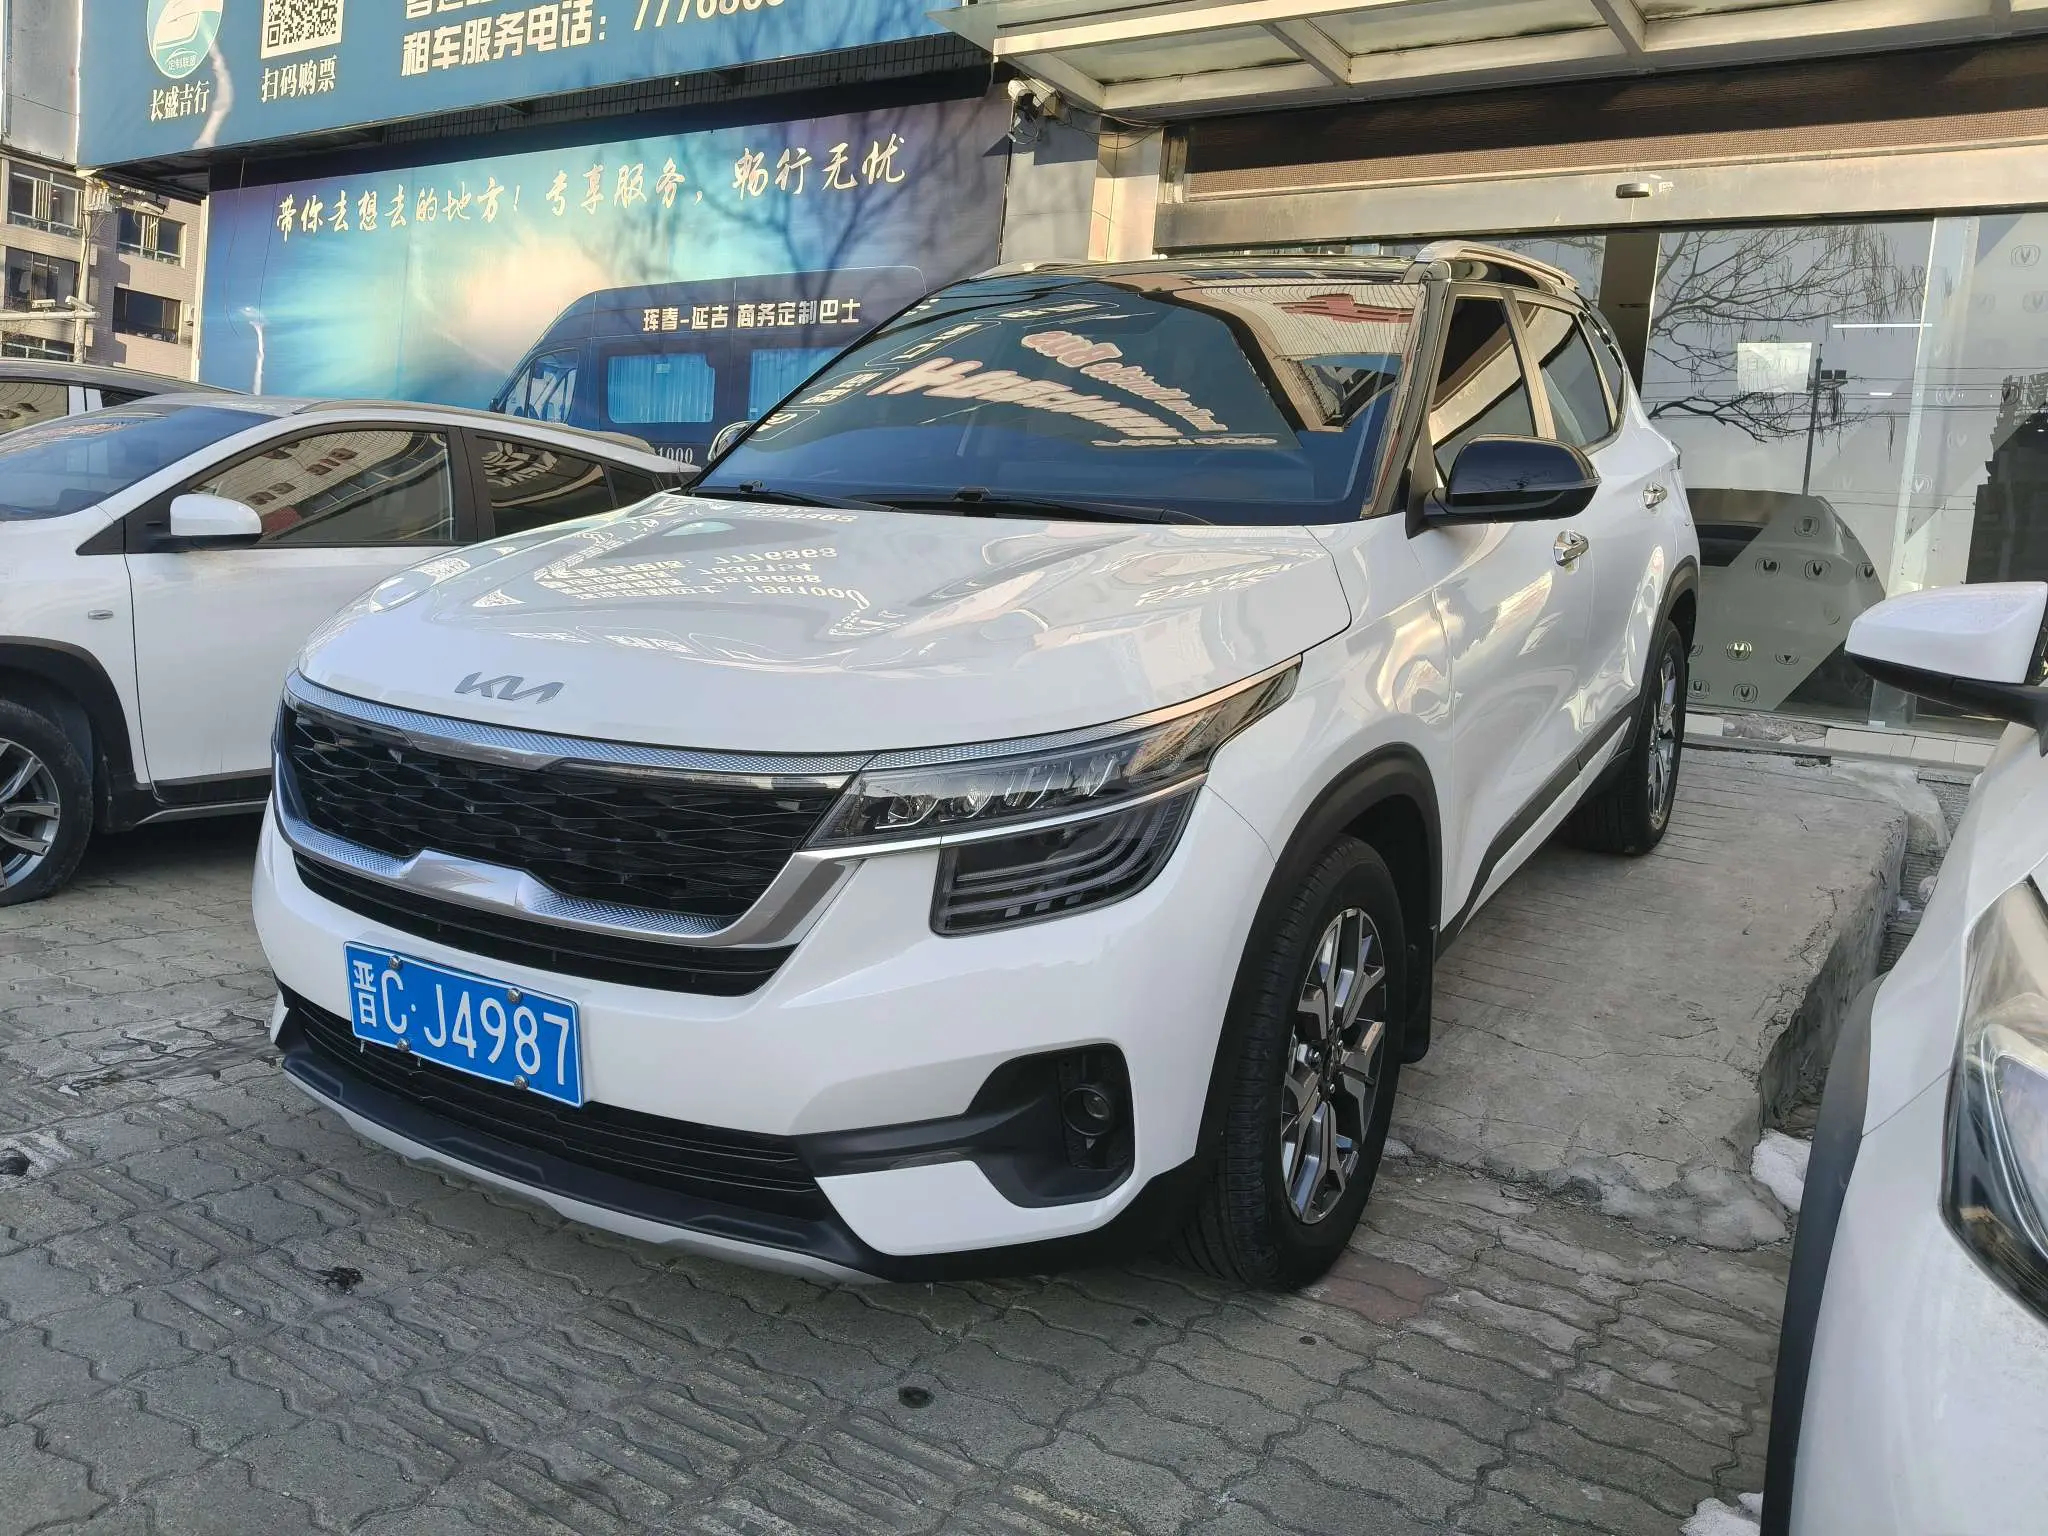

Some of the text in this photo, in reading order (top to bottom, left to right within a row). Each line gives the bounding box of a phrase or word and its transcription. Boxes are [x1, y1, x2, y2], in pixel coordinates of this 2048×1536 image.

[150, 80, 210, 122] 长盛吉行
[261, 54, 338, 103] 扫码购票
[732, 133, 905, 200] 畅行无忧
[643, 298, 861, 332] 珲春-延吉 商务定制巴士
